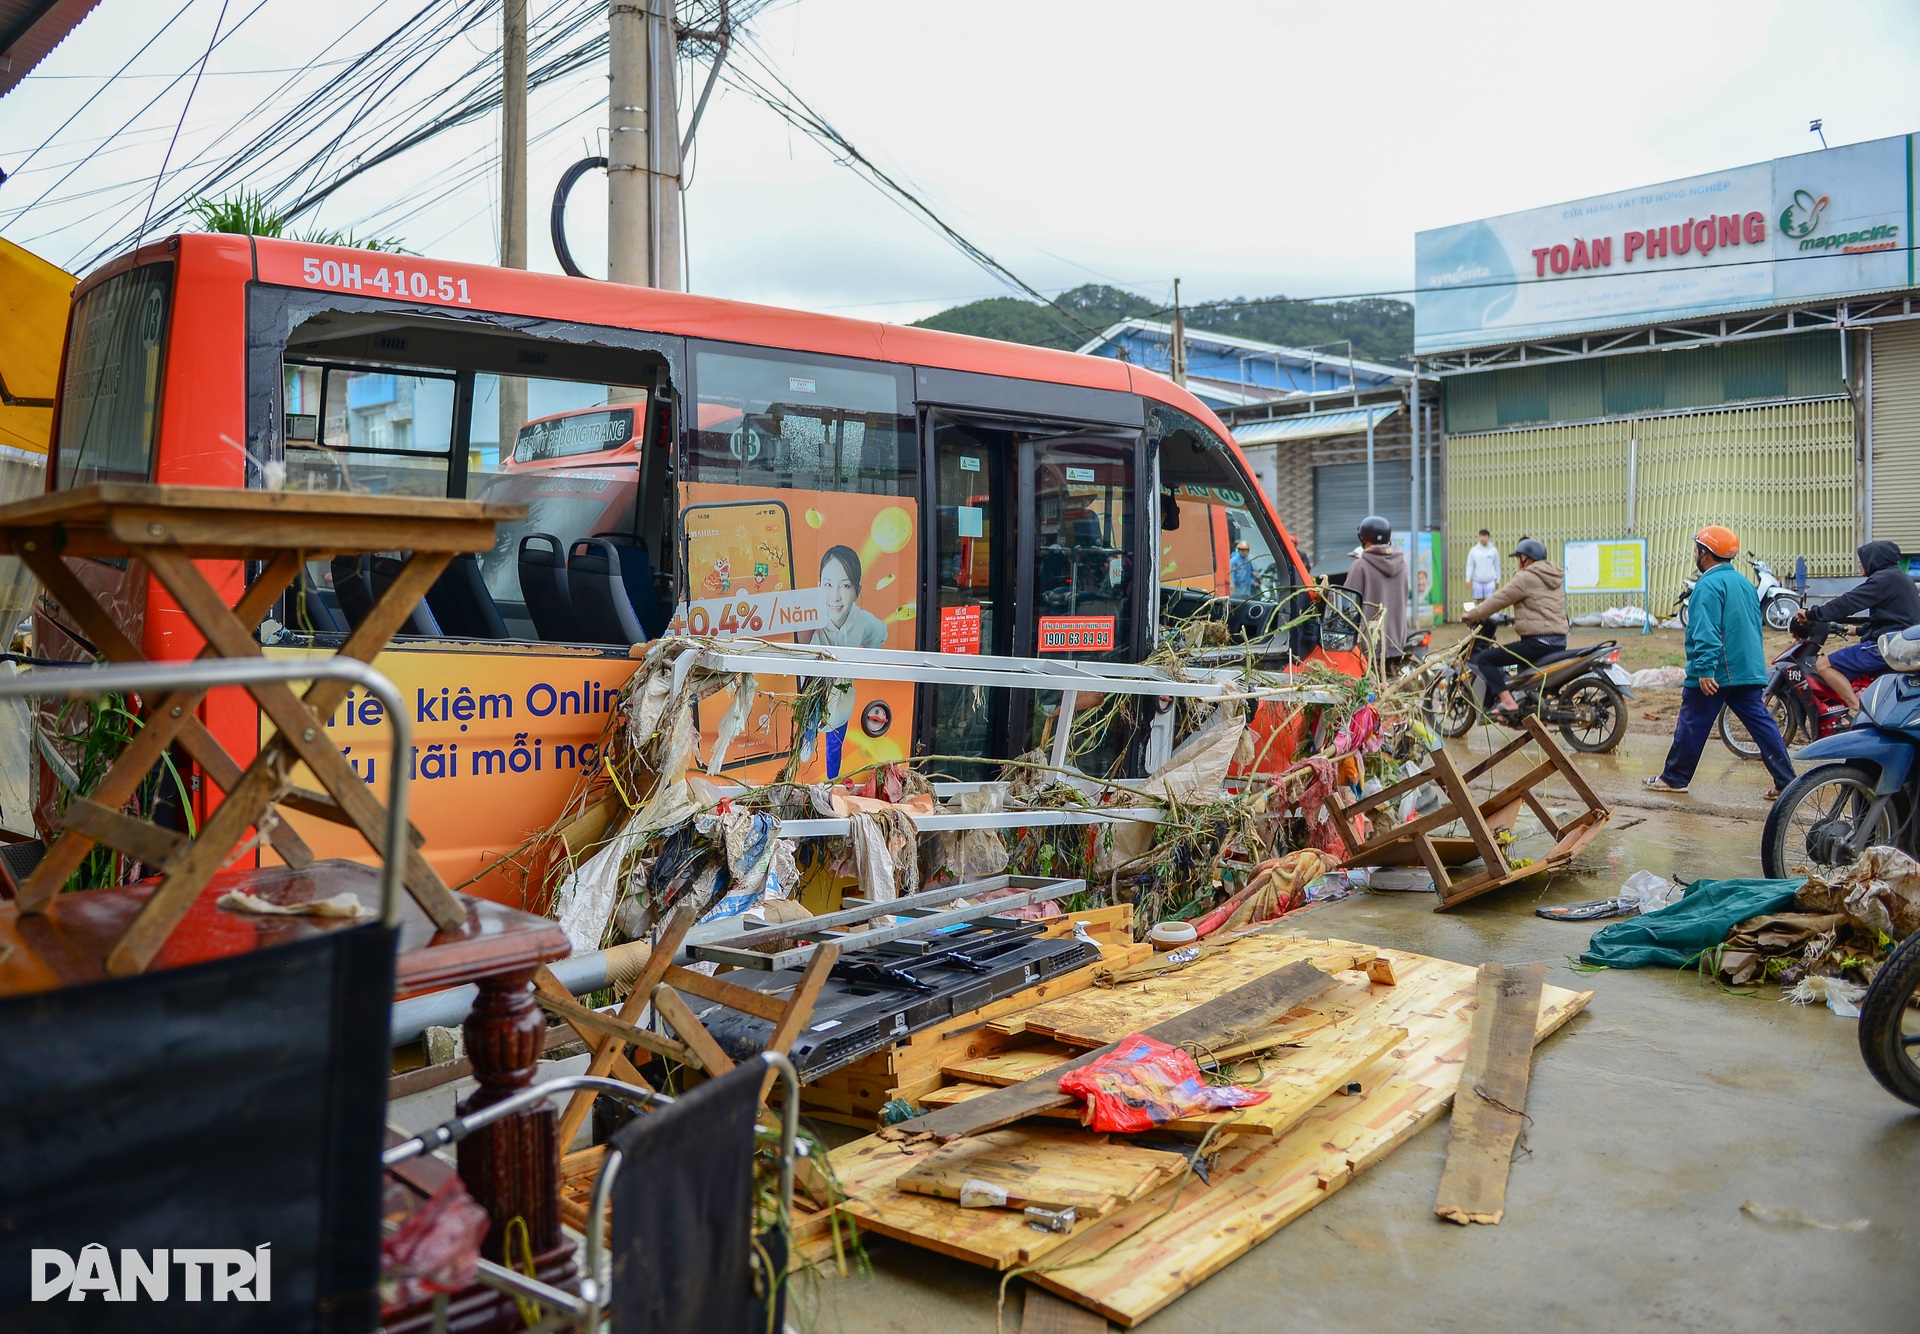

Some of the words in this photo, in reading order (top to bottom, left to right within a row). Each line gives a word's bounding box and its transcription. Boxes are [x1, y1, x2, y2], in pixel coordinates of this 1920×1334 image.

[1532, 235, 1612, 277] TOÀN
[1624, 210, 1766, 262] PHƯỢNG
[1799, 224, 1899, 251] mappacific
[303, 257, 472, 304] 50H-410.51
[1430, 264, 1490, 288] syngenta
[143, 297, 162, 341] 03
[588, 419, 626, 444] TRANG
[669, 601, 763, 636] +0.4%
[1044, 632, 1066, 646] 1900
[1068, 632, 1080, 646] 63
[1082, 631, 1094, 646] 84
[1096, 631, 1108, 646] 94
[417, 687, 513, 732] kiệm
[1826, 704, 1845, 712] YAMAHA
[472, 732, 542, 776] mỗi
